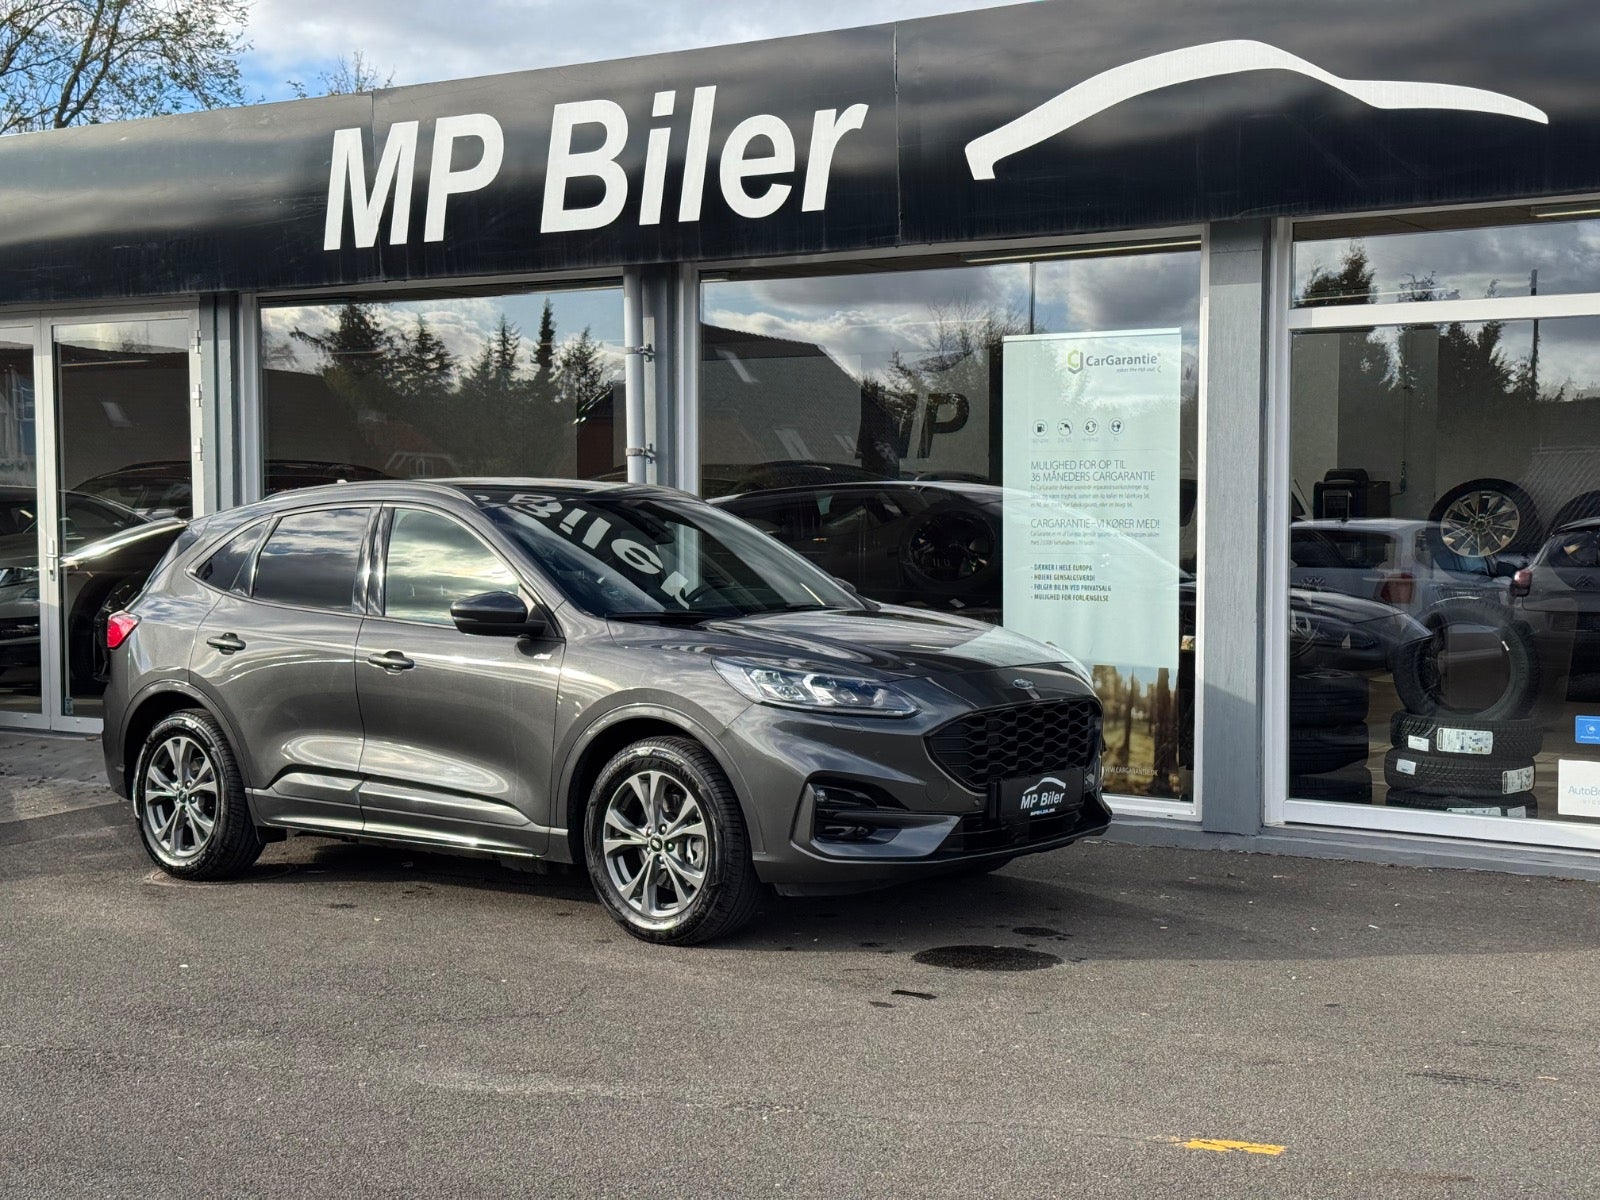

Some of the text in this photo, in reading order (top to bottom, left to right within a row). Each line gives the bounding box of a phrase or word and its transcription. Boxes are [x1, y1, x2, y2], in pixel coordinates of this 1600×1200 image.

[323, 85, 869, 251] MP Biler
[1086, 353, 1157, 367] CarGarantie
[1030, 460, 1127, 470] MULIGHED FOR OP TIL
[1031, 470, 1156, 482] 36 MÅNEDERS CARGARANTIE
[1106, 518, 1135, 529] KØRER
[1136, 519, 1160, 529] MED!
[1034, 583, 1053, 591] FØLGER
[1081, 584, 1112, 592] PRIVATSALG
[1034, 593, 1061, 601] MULIGHED
[1020, 791, 1065, 810] MP Biler
